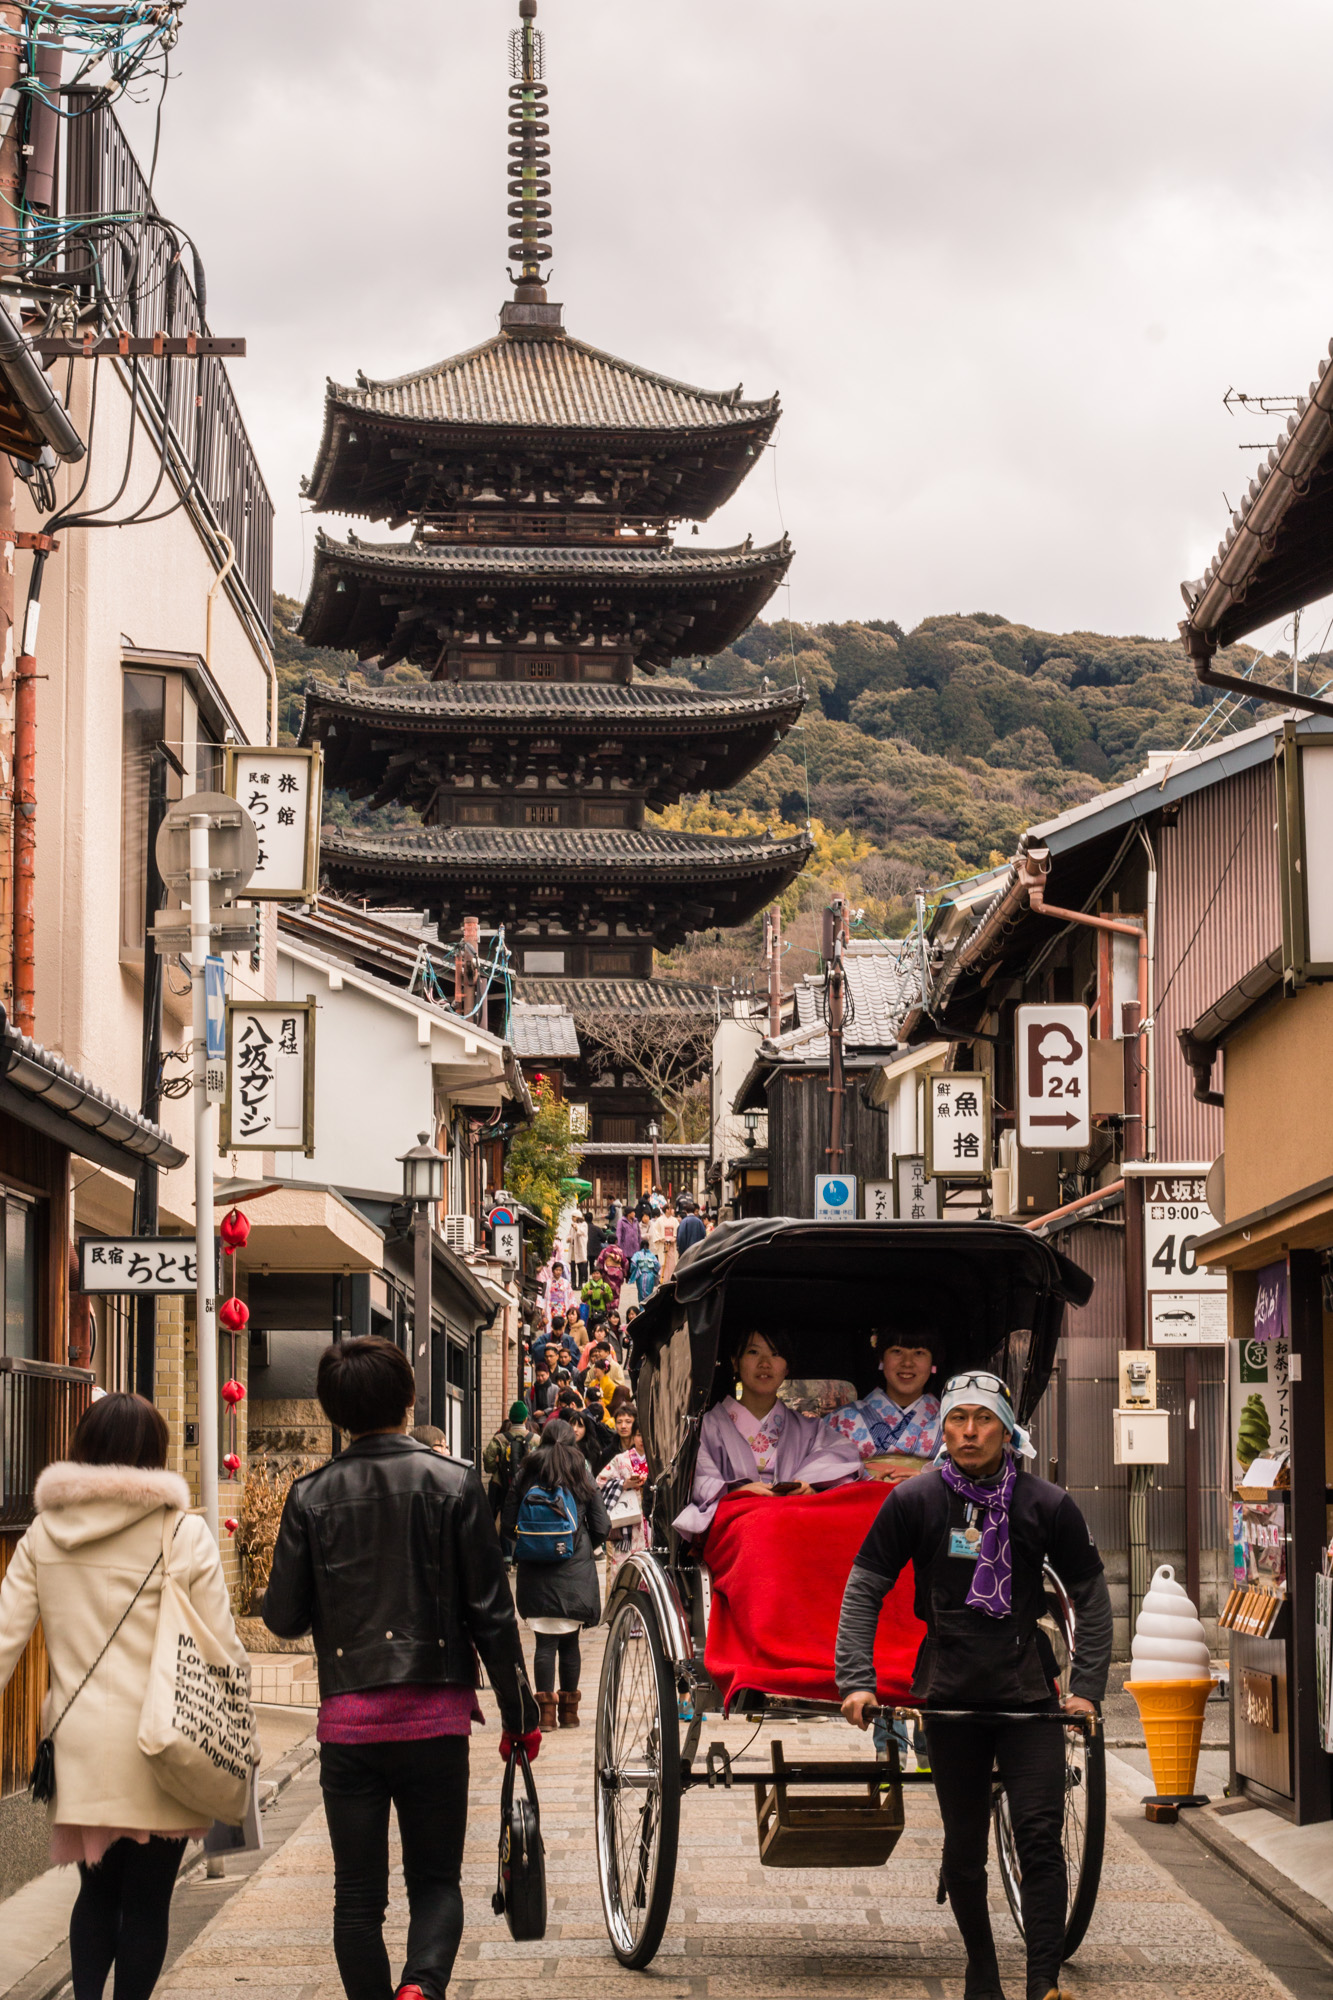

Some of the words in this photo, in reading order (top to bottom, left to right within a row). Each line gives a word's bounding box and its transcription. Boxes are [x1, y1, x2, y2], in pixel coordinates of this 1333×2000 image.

[248, 772, 271, 784] 民宿
[277, 773, 300, 826] 旅館
[278, 1018, 299, 1055] 月極
[237, 1016, 274, 1138] 八坂ガレージ
[1048, 1077, 1081, 1098] 24
[936, 1082, 951, 1118] 鮮魚
[91, 1246, 124, 1265] 民宿
[1250, 1340, 1267, 1364] 京
[172, 1716, 197, 1743] Los
[199, 1737, 247, 1780] Angeles
[175, 1705, 254, 1767] Tokyo/Vanco
